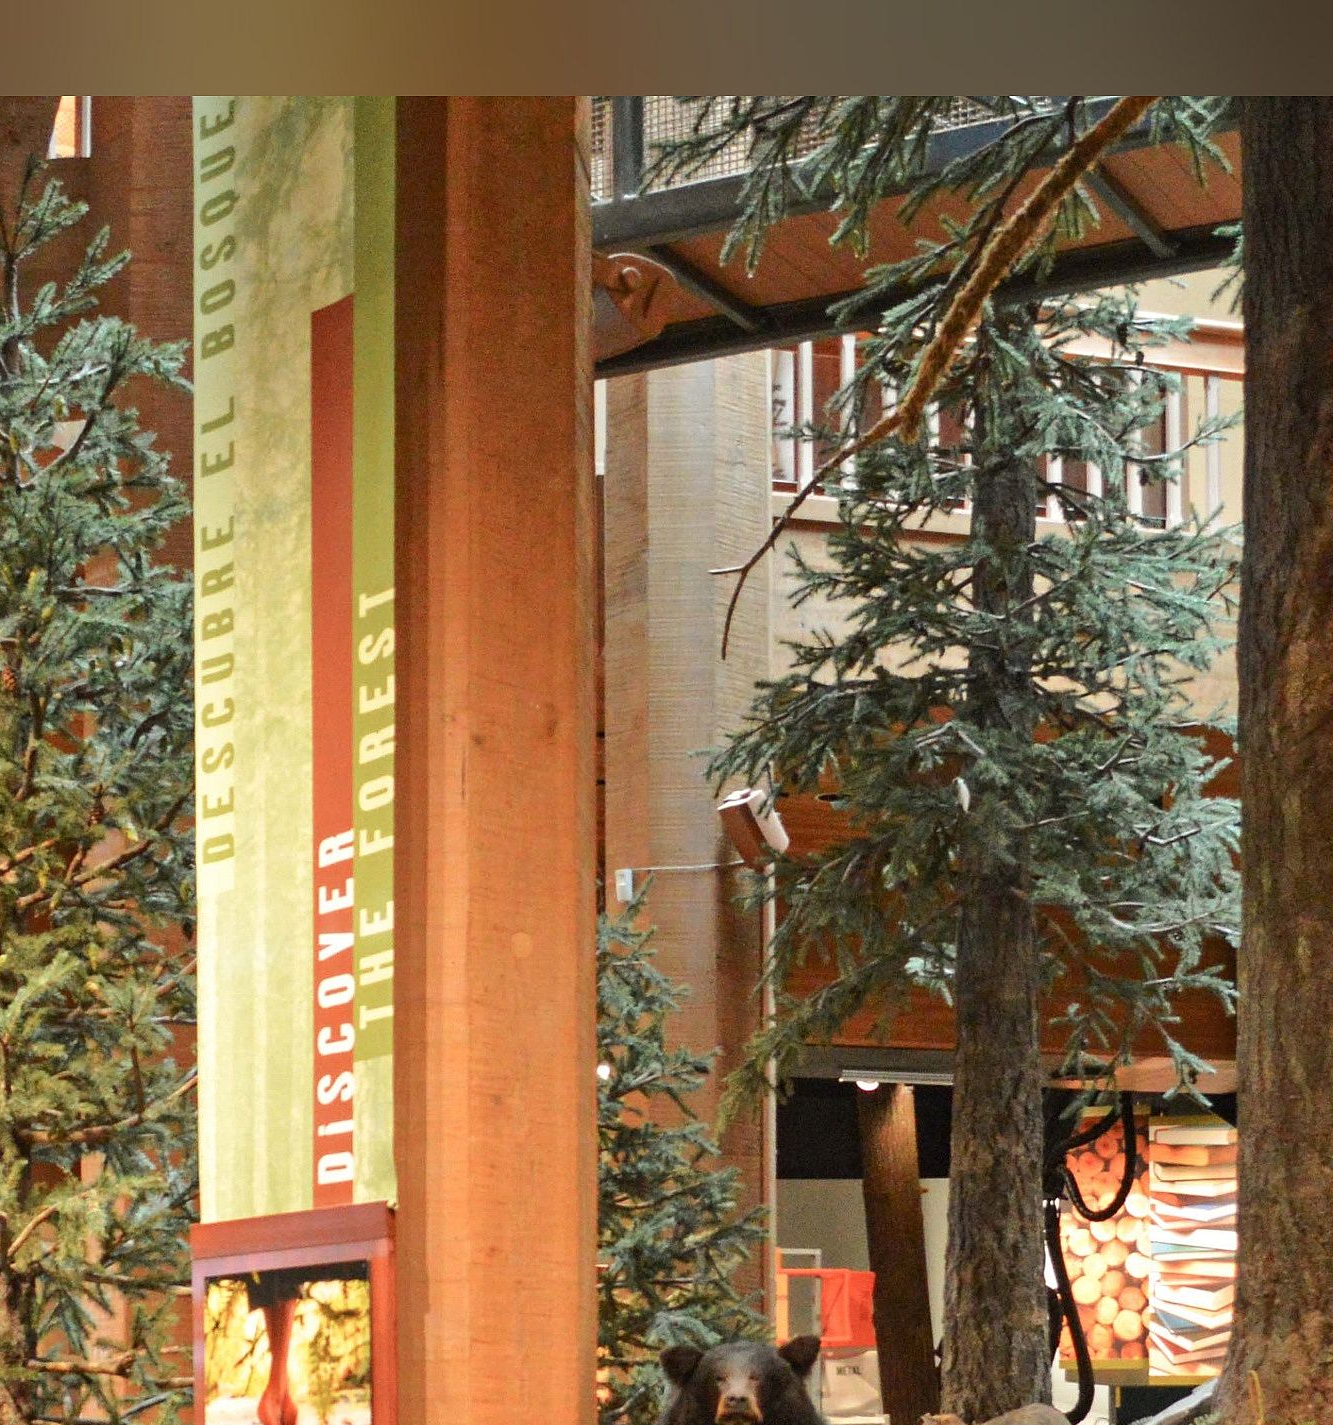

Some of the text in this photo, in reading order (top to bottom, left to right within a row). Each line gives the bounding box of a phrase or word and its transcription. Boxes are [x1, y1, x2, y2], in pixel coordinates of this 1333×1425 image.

[200, 97, 239, 864] DESCUBRE EL BOSQUE
[359, 586, 396, 1030] THE FOREST
